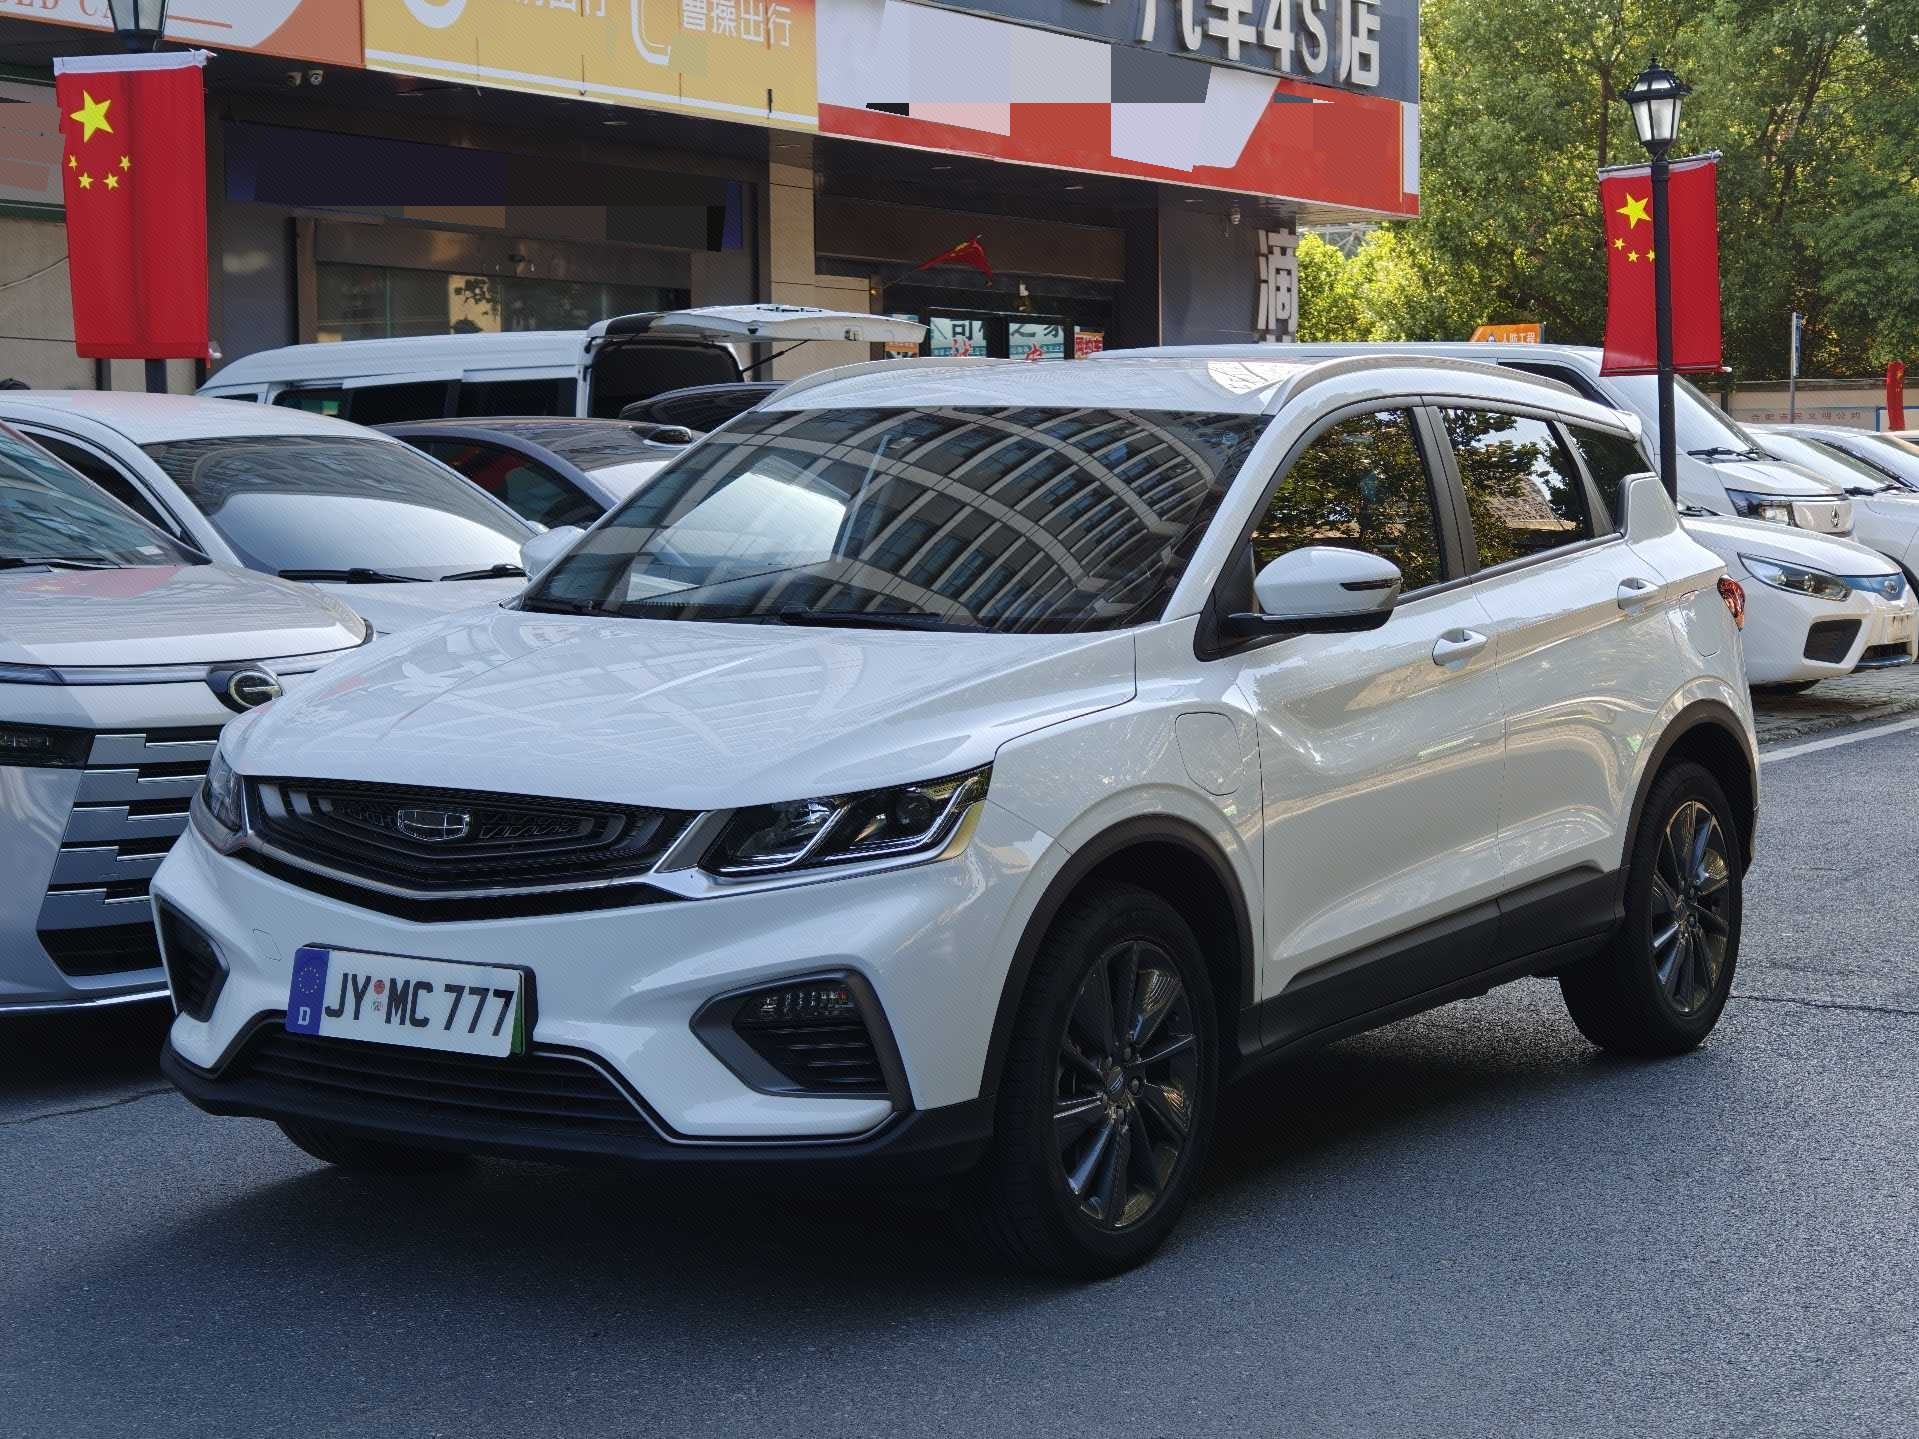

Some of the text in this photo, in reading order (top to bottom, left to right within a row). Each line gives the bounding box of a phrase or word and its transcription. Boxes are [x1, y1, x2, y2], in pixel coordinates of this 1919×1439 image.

[681, 0, 791, 47] 曹操出行
[297, 1006, 311, 1026] D
[324, 972, 515, 1037] JY MC 777
